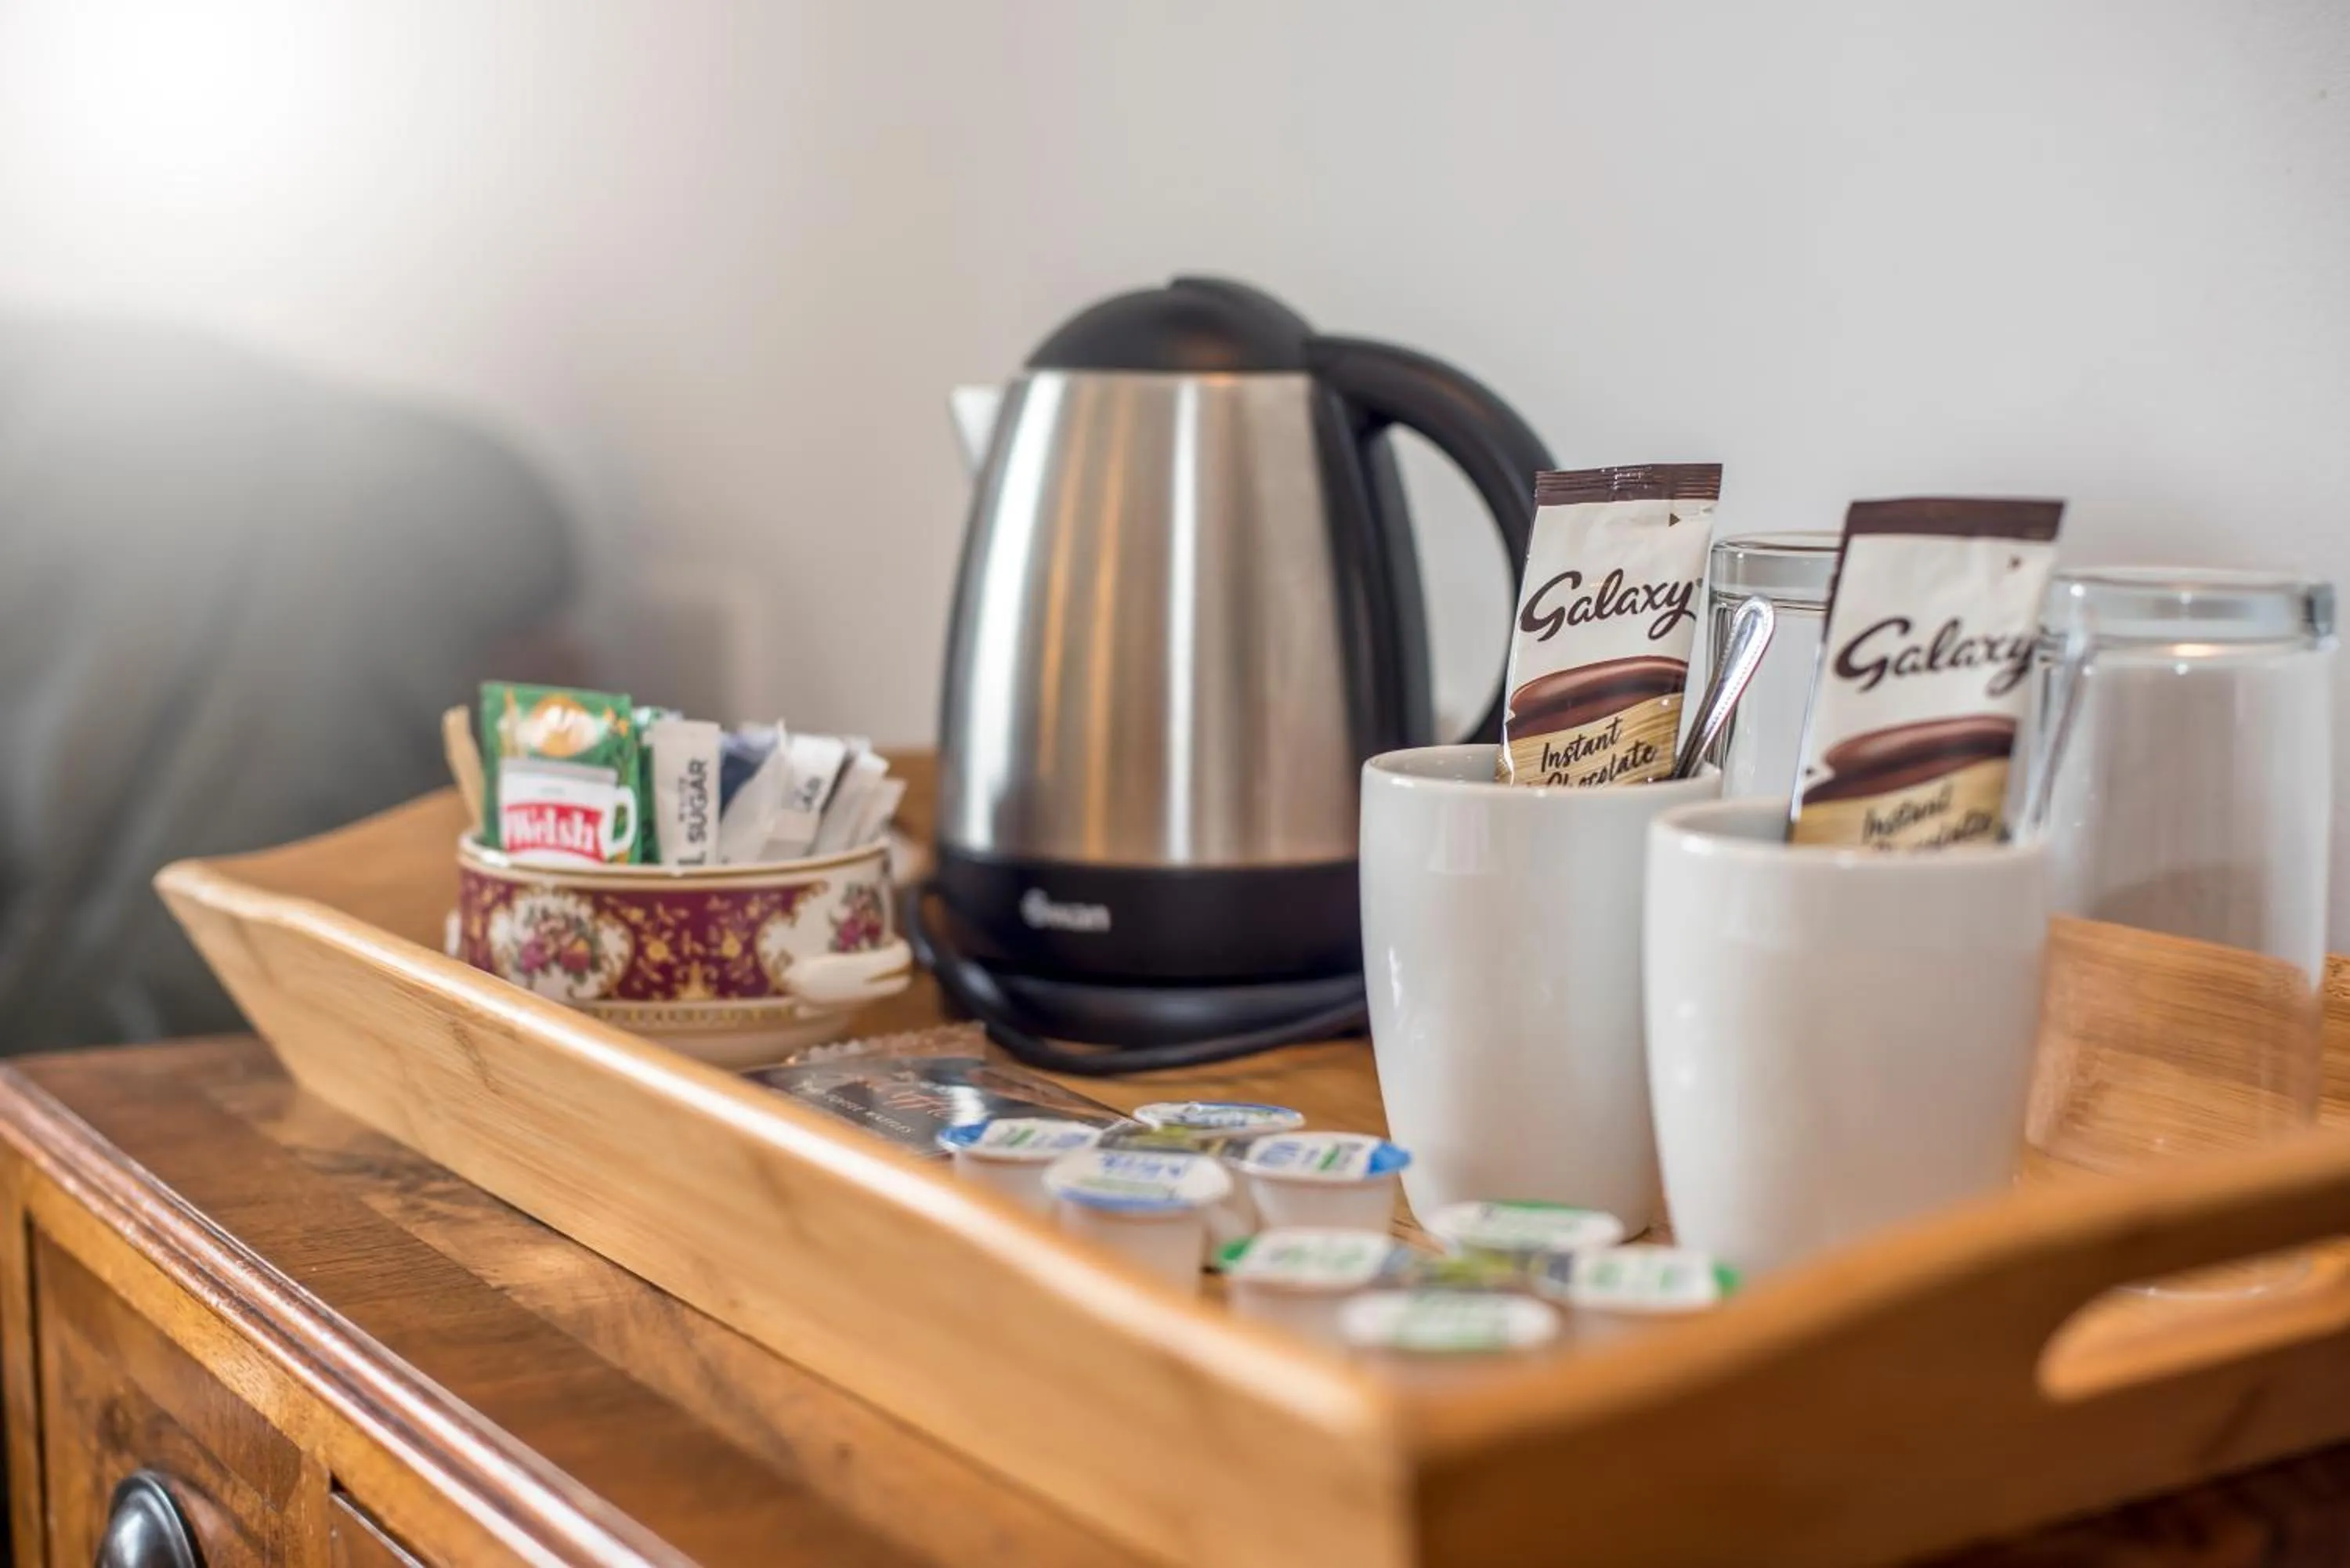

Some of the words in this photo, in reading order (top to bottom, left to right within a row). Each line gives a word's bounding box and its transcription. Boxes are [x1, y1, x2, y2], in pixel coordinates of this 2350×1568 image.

[1520, 569, 1697, 642] Galaxy
[1833, 616, 2035, 698] Galaxy
[1541, 716, 1624, 773] Instant
[687, 758, 707, 843] SUGAR
